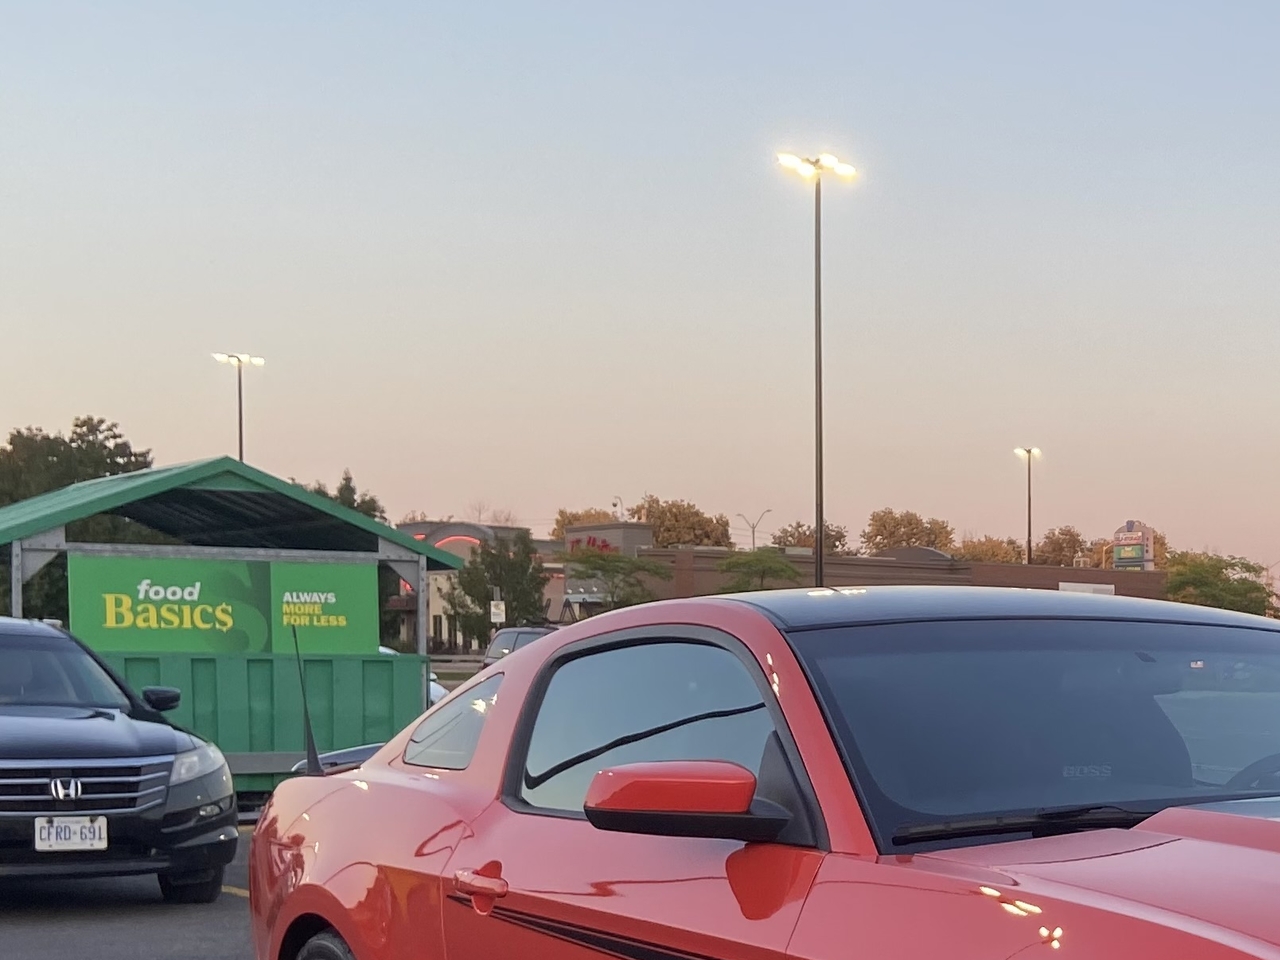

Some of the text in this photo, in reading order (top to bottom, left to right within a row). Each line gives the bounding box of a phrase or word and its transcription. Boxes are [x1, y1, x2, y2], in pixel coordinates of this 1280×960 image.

[137, 579, 201, 601] food
[283, 591, 336, 603] ALWAYS
[283, 603, 322, 614] MORE
[283, 615, 346, 626] FOR LESS
[39, 824, 71, 841] CFRD
